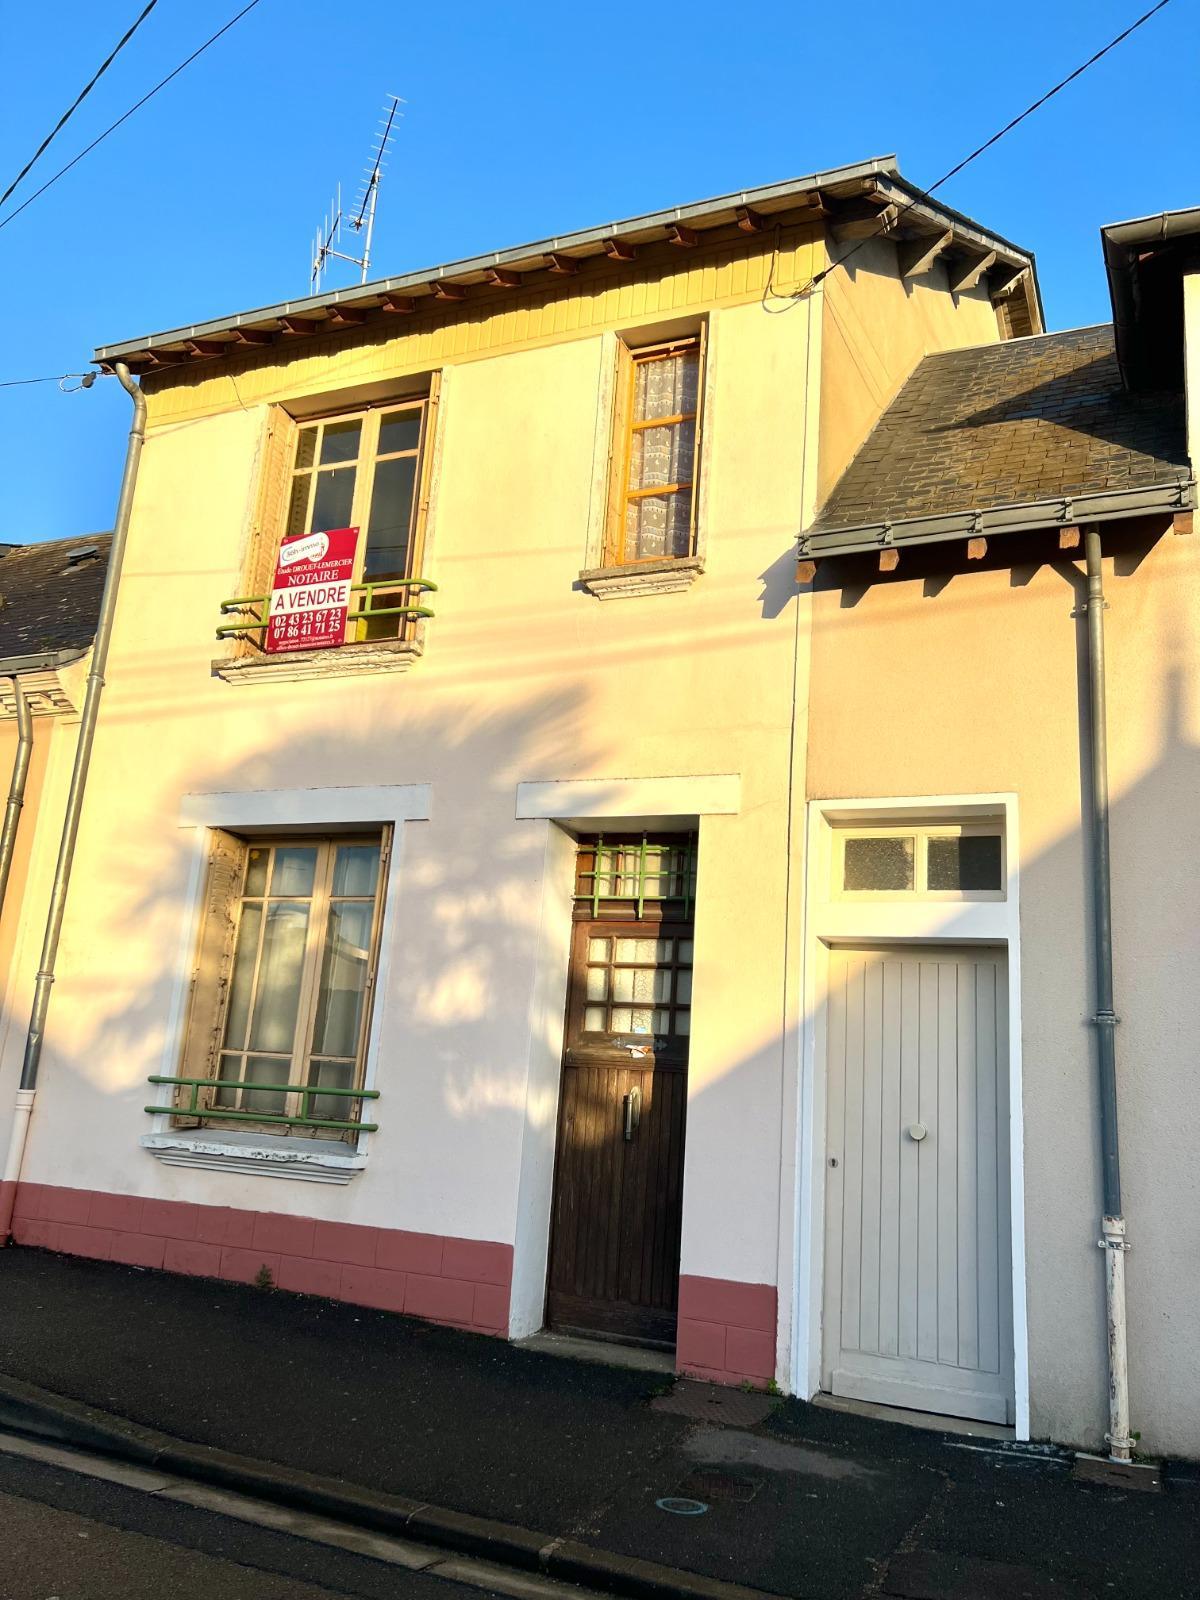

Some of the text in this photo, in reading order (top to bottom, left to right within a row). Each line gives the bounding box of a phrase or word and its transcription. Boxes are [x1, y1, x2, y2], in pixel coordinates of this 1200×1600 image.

[293, 558, 353, 573] DROUET-LEMERCIER
[287, 570, 340, 586] NOTAIRE
[275, 586, 347, 610] A VENDRE
[275, 616, 287, 627] 02
[289, 614, 300, 625] 43
[302, 612, 314, 624] 23
[316, 610, 328, 622] 67
[330, 608, 342, 620] 23
[274, 620, 341, 639] 07 86 41 71 25
